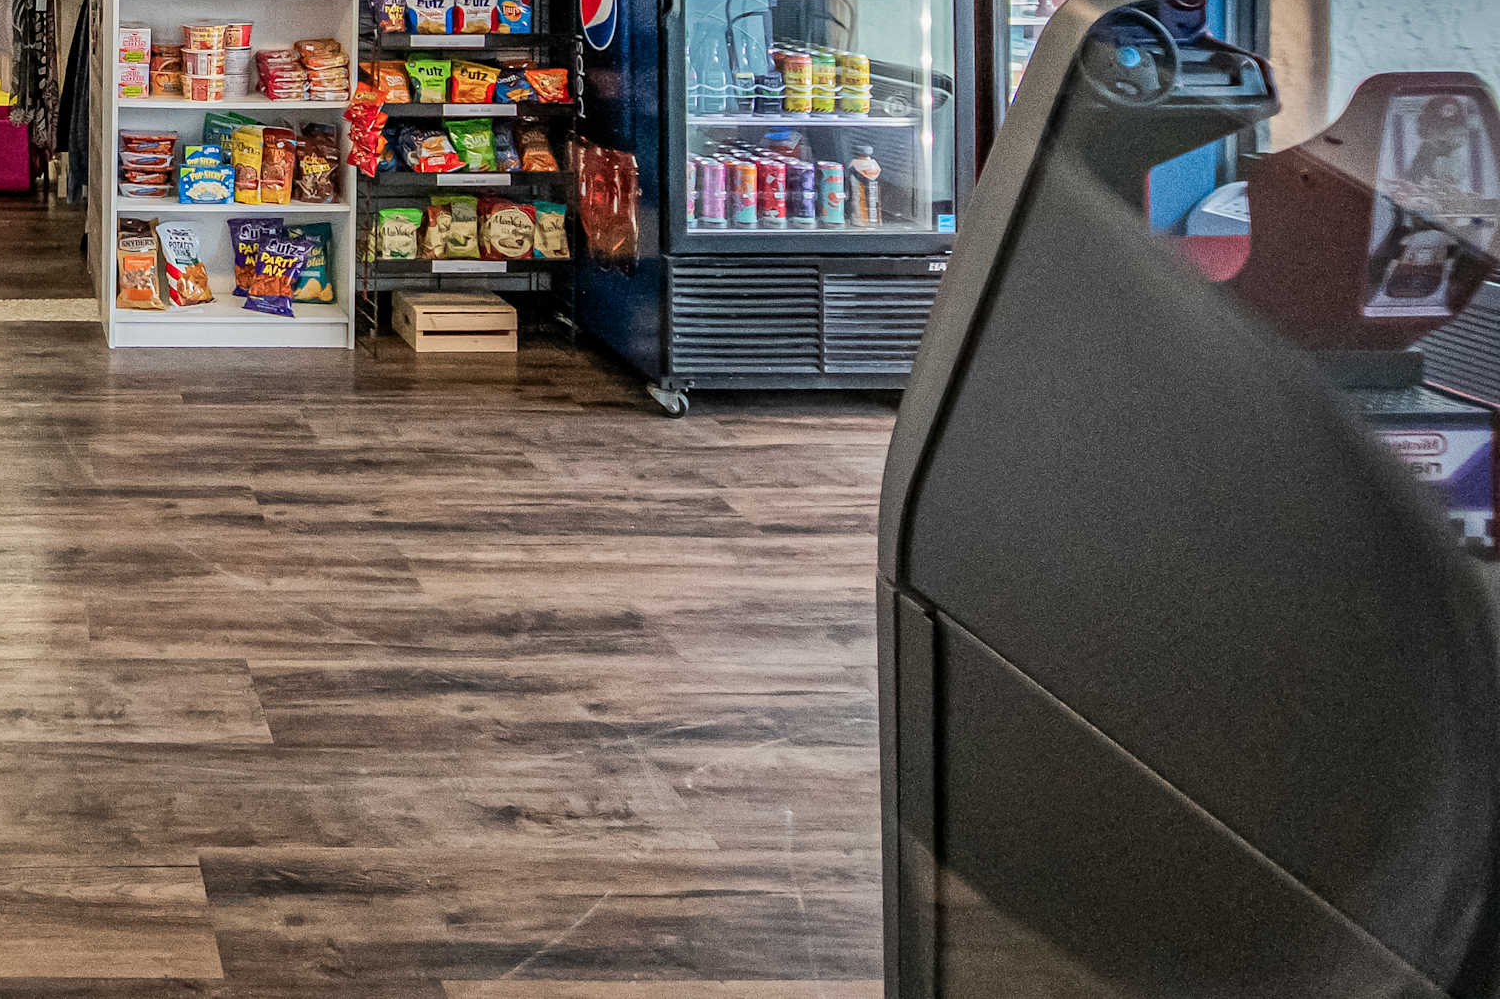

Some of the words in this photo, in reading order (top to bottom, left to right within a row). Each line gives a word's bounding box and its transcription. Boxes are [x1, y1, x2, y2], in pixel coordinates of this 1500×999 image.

[238, 242, 260, 255] PAR
[260, 252, 298, 269] PARTY
[262, 264, 287, 278] MIX
